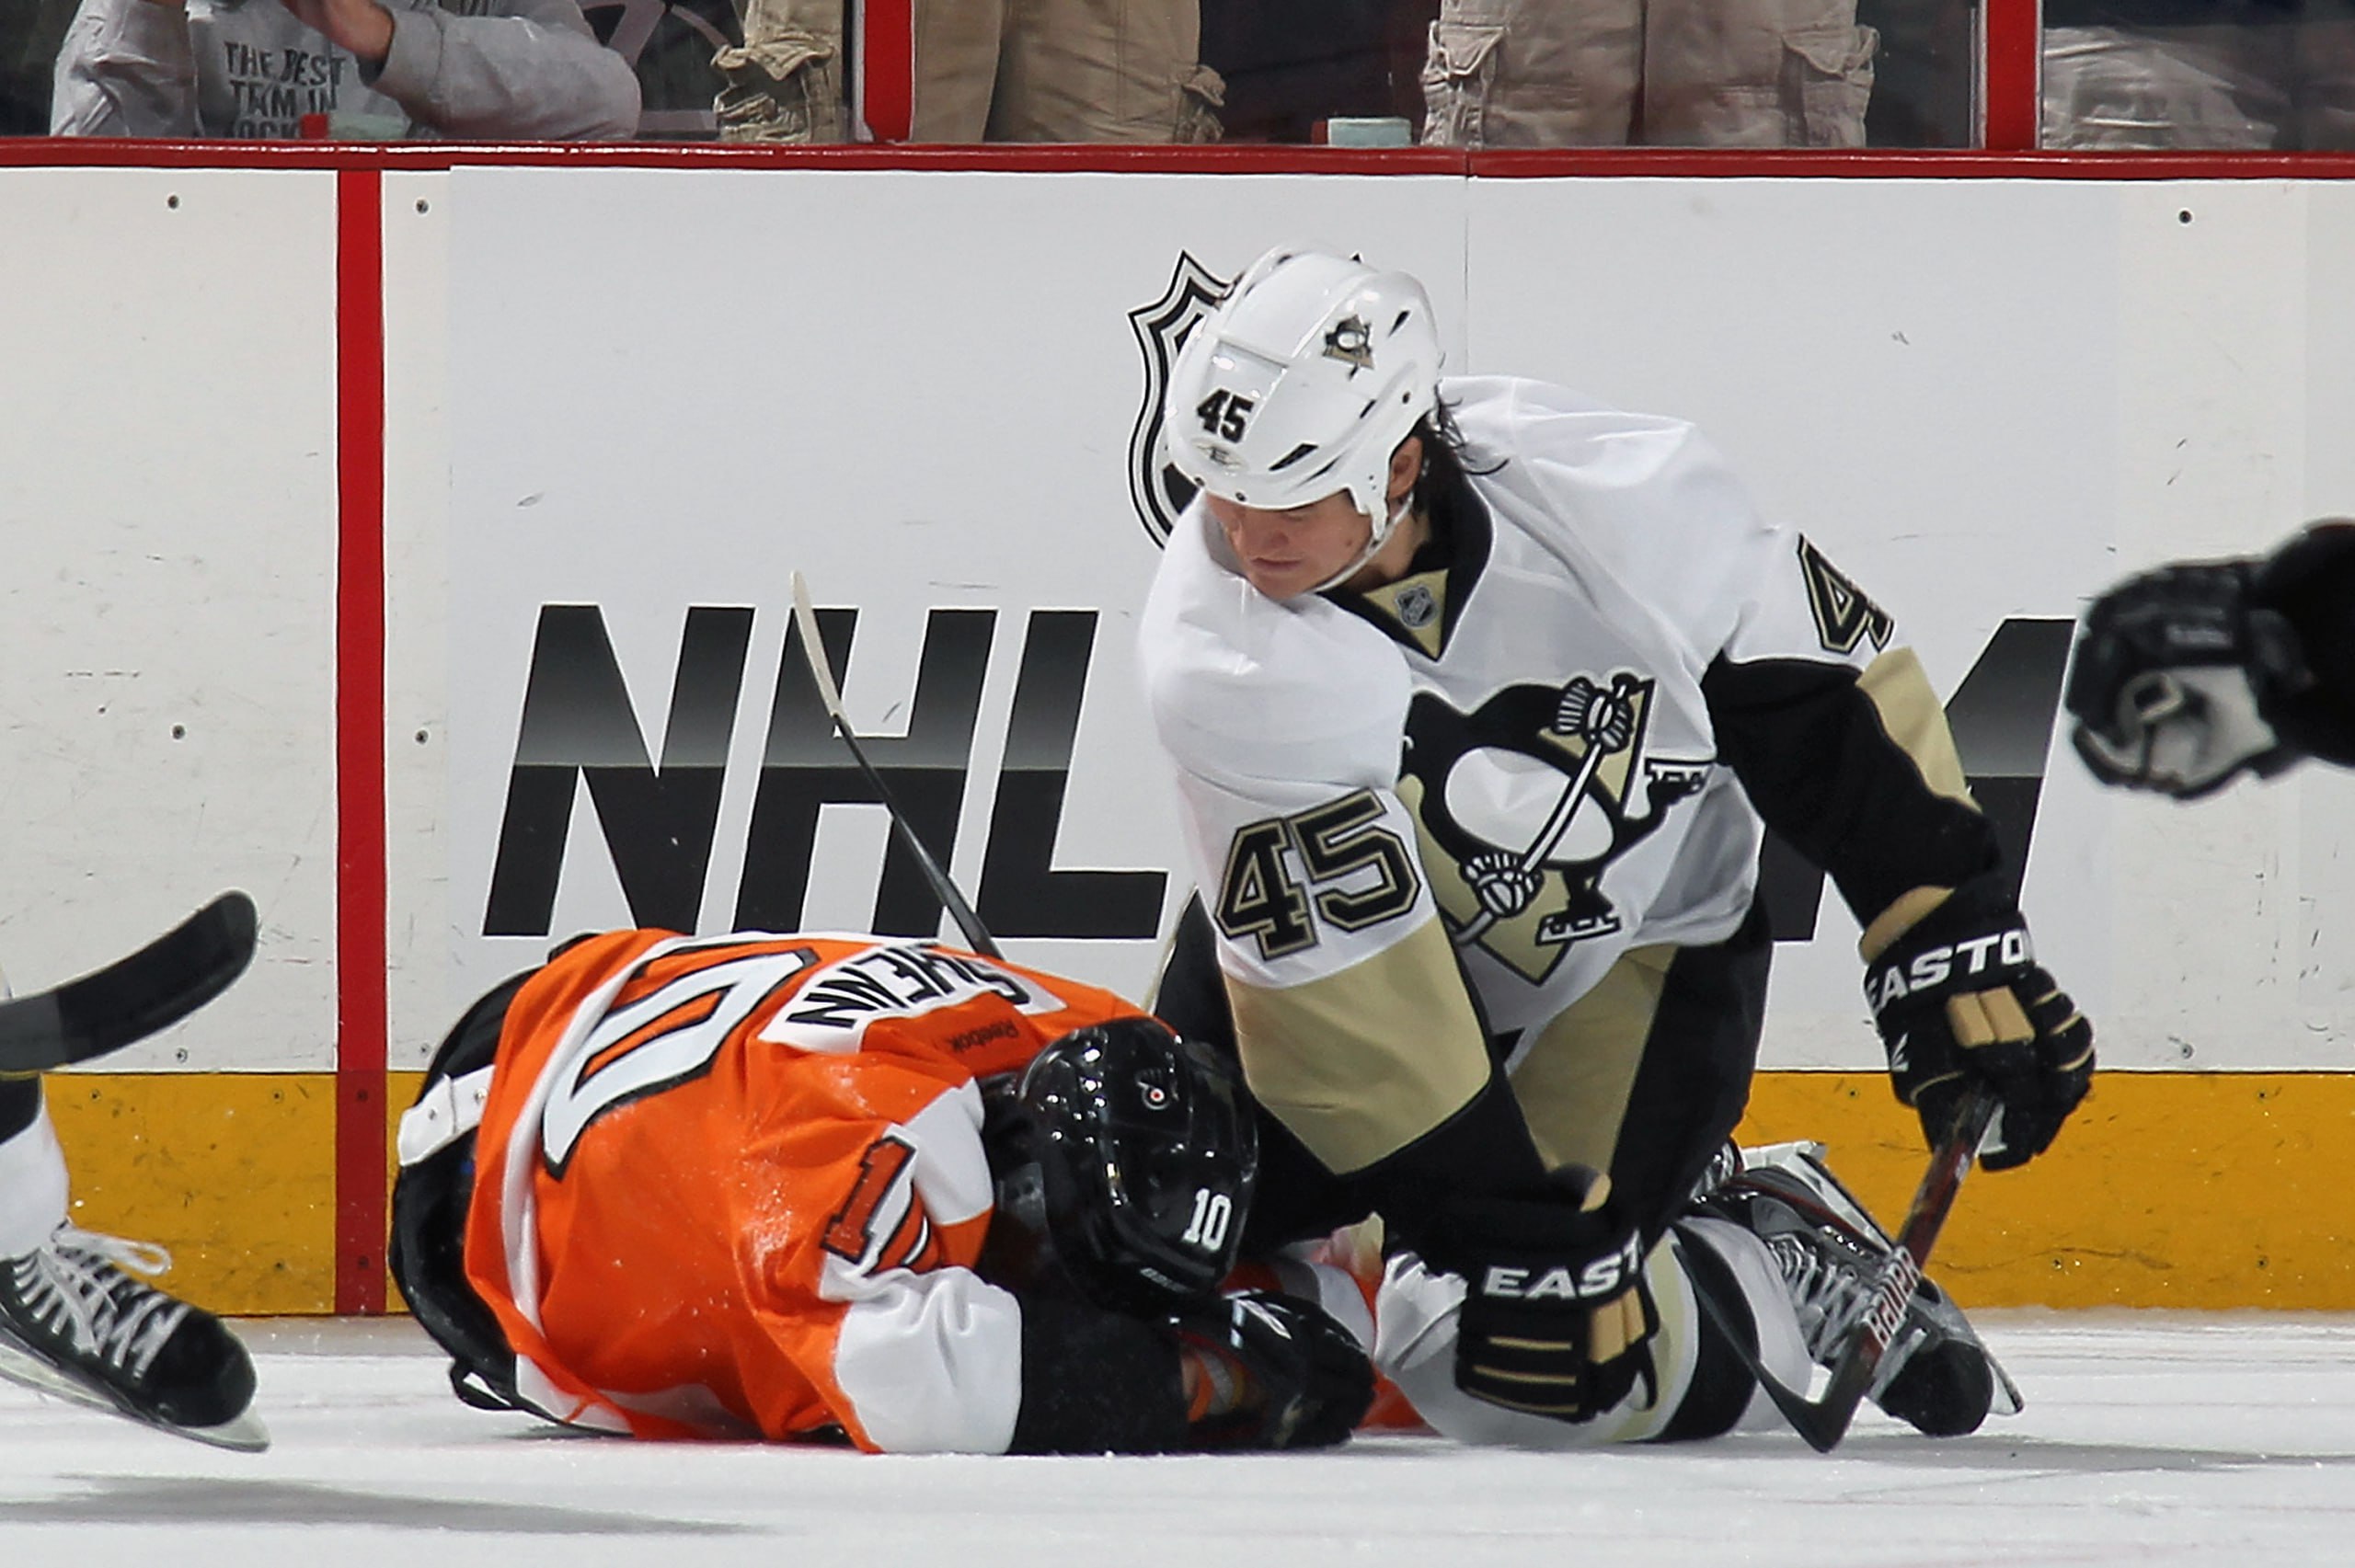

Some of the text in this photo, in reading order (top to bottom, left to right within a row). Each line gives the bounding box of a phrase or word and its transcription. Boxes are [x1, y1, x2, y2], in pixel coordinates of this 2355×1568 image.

[224, 40, 346, 86] THE BEST
[230, 80, 338, 118] TEAM IN
[1196, 387, 1256, 444] 45
[482, 603, 1168, 938] NHL
[1213, 787, 1422, 961] 45
[1181, 1187, 1232, 1252] 10
